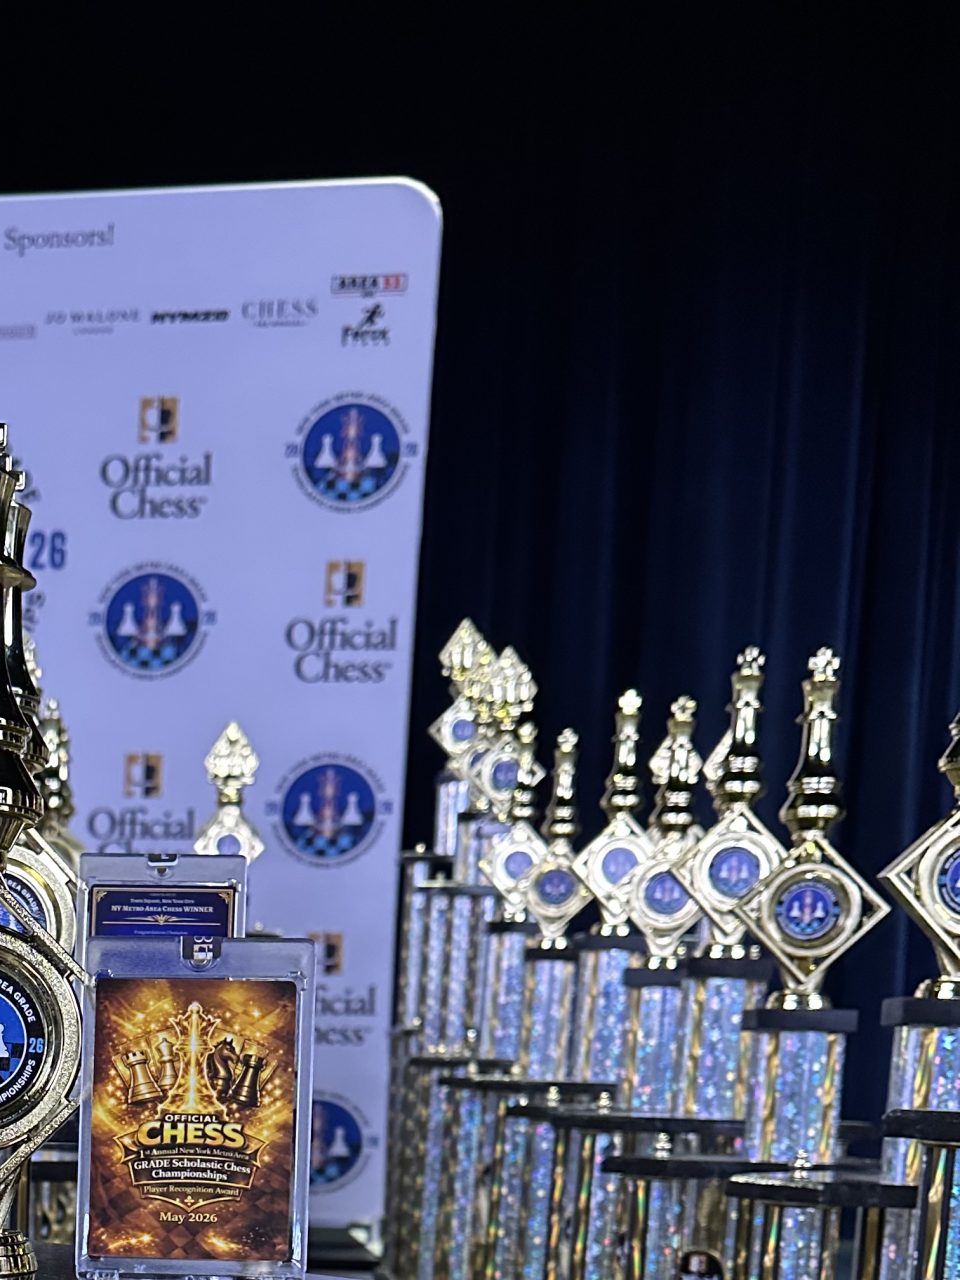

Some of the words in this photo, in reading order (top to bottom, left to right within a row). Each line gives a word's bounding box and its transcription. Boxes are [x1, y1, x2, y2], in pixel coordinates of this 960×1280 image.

[4, 223, 115, 258] Sponsors!
[100, 451, 213, 488] Official
[110, 489, 202, 520] Chess
[30, 531, 67, 570] 26
[285, 617, 397, 651] Official
[294, 652, 386, 684] Chess
[86, 806, 195, 841] Official
[13, 991, 37, 1024] GRADE
[29, 1038, 45, 1053] 26
[165, 1114, 219, 1123] OFFICIAL
[137, 1121, 246, 1148] CHESS
[151, 1148, 178, 1156] Annual
[195, 1147, 211, 1155] York
[134, 1159, 170, 1170] GRADE
[172, 1159, 223, 1170] Scholastic
[224, 1162, 251, 1174] Chess
[151, 1169, 228, 1181] Championships
[144, 1185, 167, 1194] Player
[169, 1185, 214, 1194] Recognition
[215, 1186, 239, 1196] Award
[159, 1211, 185, 1224] May
[188, 1212, 218, 1223] 2026
